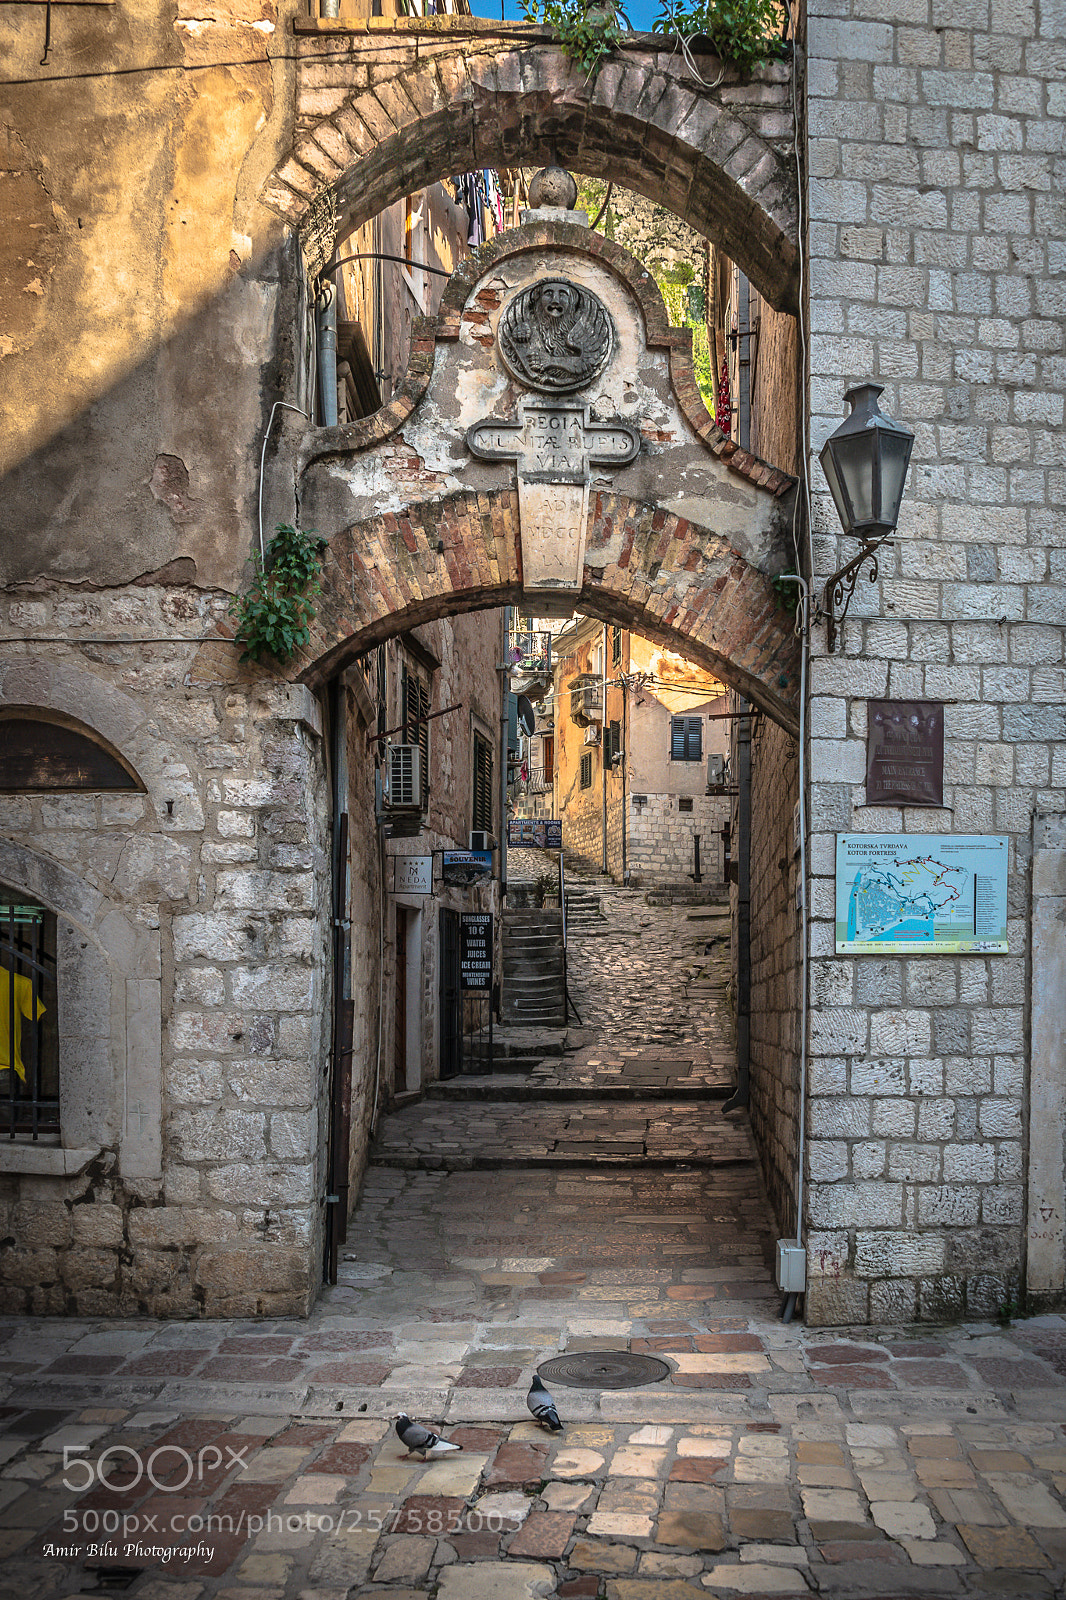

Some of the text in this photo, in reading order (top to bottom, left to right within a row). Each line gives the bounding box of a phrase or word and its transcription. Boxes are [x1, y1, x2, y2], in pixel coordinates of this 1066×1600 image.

[524, 416, 582, 430] REGIA
[536, 455, 571, 468] VIA
[399, 876, 427, 884] NEDA
[462, 915, 490, 923] SUNGLASSES
[468, 926, 477, 935] 10
[466, 939, 486, 947] WATER
[467, 950, 487, 958] JUICES
[461, 960, 491, 969] ICE CREAM
[466, 977, 486, 986] WINES
